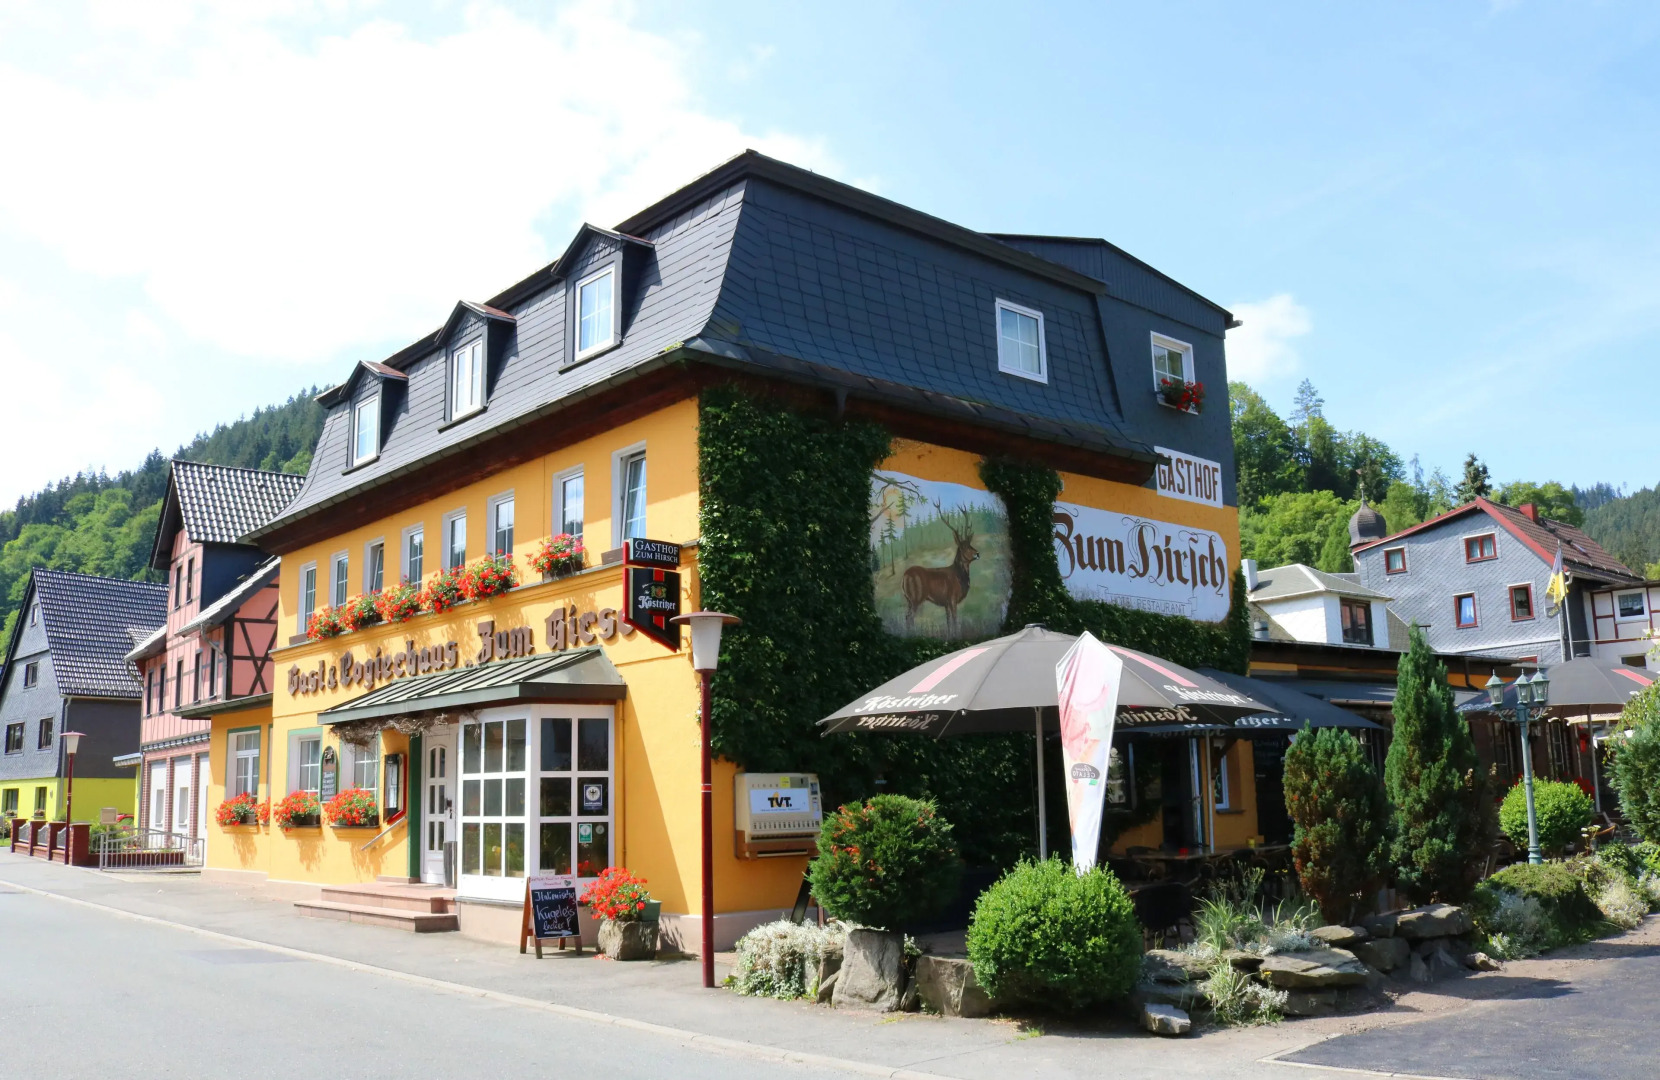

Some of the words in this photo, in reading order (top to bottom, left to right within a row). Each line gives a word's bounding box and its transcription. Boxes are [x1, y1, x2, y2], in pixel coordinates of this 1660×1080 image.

[1157, 453, 1220, 502] GASTHOF
[635, 540, 678, 556] GASTHOF
[635, 550, 653, 559] ZUM
[654, 552, 678, 563] HIRSCH
[1053, 512, 1126, 580] Zum
[1127, 522, 1227, 597] Hirsch
[637, 595, 676, 611] Köstritzer
[287, 659, 326, 697] Gast
[327, 665, 338, 690] &
[855, 692, 959, 713] Köstritzer
